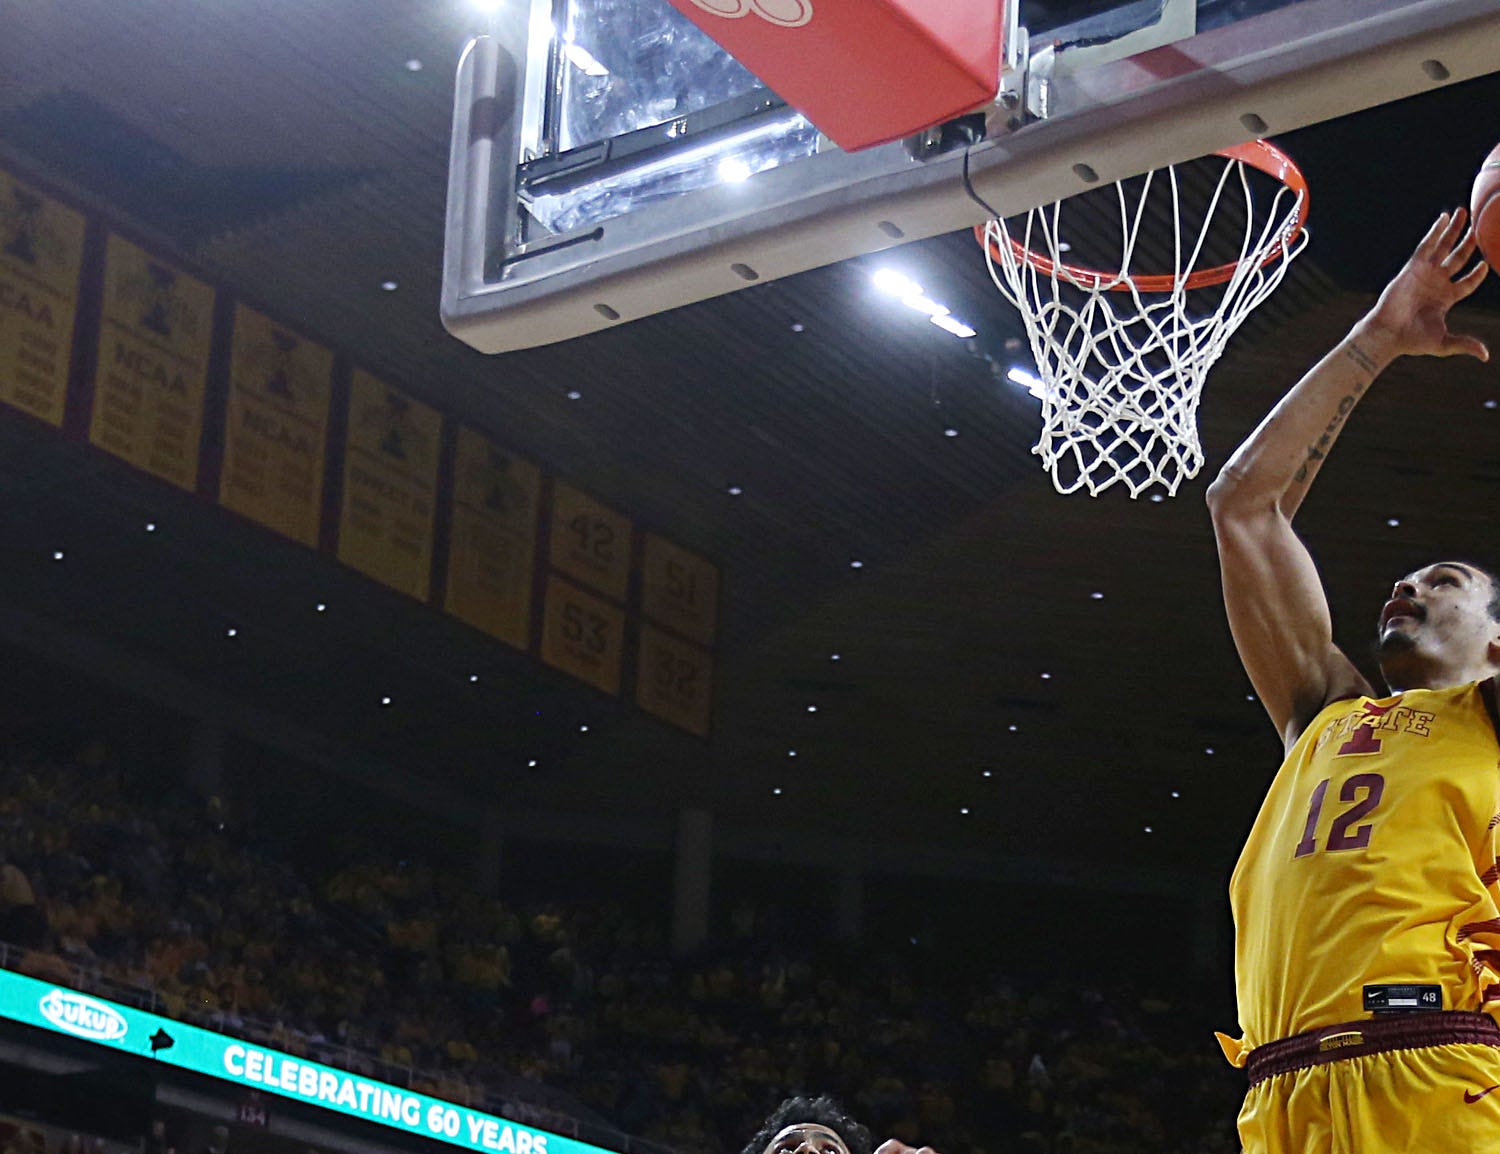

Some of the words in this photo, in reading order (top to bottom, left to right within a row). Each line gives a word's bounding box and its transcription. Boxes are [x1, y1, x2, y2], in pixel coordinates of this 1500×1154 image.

[115, 342, 188, 397] NCAA
[570, 514, 615, 563] 42
[666, 560, 698, 607] 51
[560, 601, 611, 653] 53
[1315, 706, 1436, 751] STATE
[1295, 772, 1385, 858] 12
[1422, 992, 1437, 1003] 48
[224, 1045, 420, 1126] CELEBRATING
[427, 1101, 460, 1137] 60
